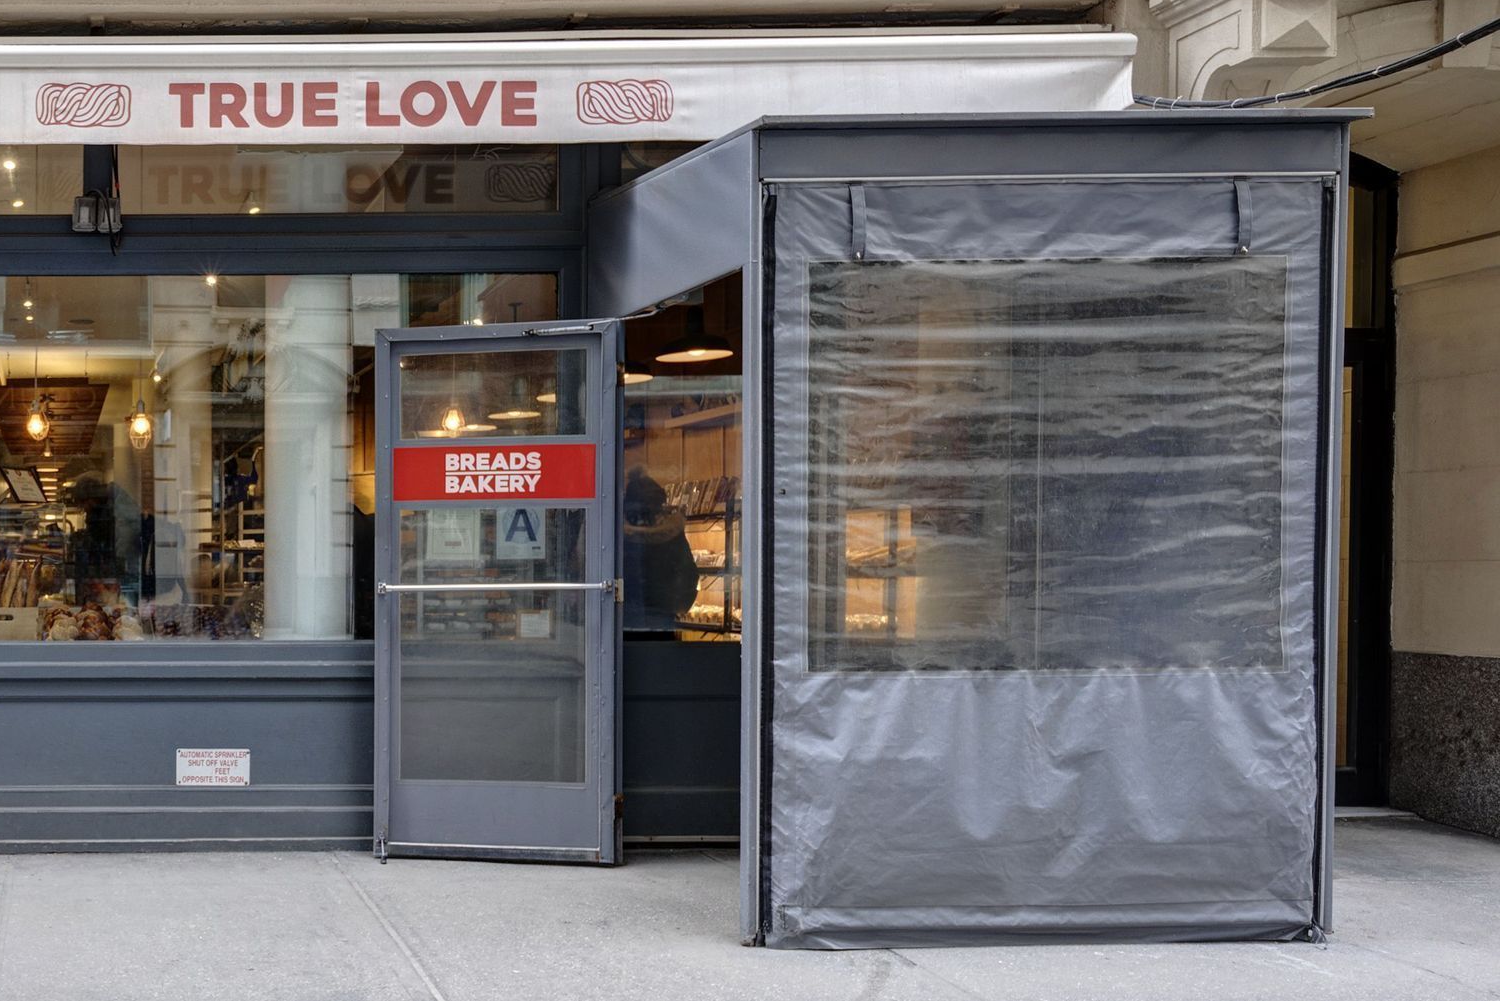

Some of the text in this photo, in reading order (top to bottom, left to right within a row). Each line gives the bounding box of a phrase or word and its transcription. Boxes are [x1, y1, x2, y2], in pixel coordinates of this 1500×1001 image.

[168, 80, 538, 129] TRUE LOVE
[312, 163, 454, 205] LOVE
[445, 452, 541, 471] BREADS
[445, 474, 541, 493] BAKERY
[504, 508, 537, 542] A
